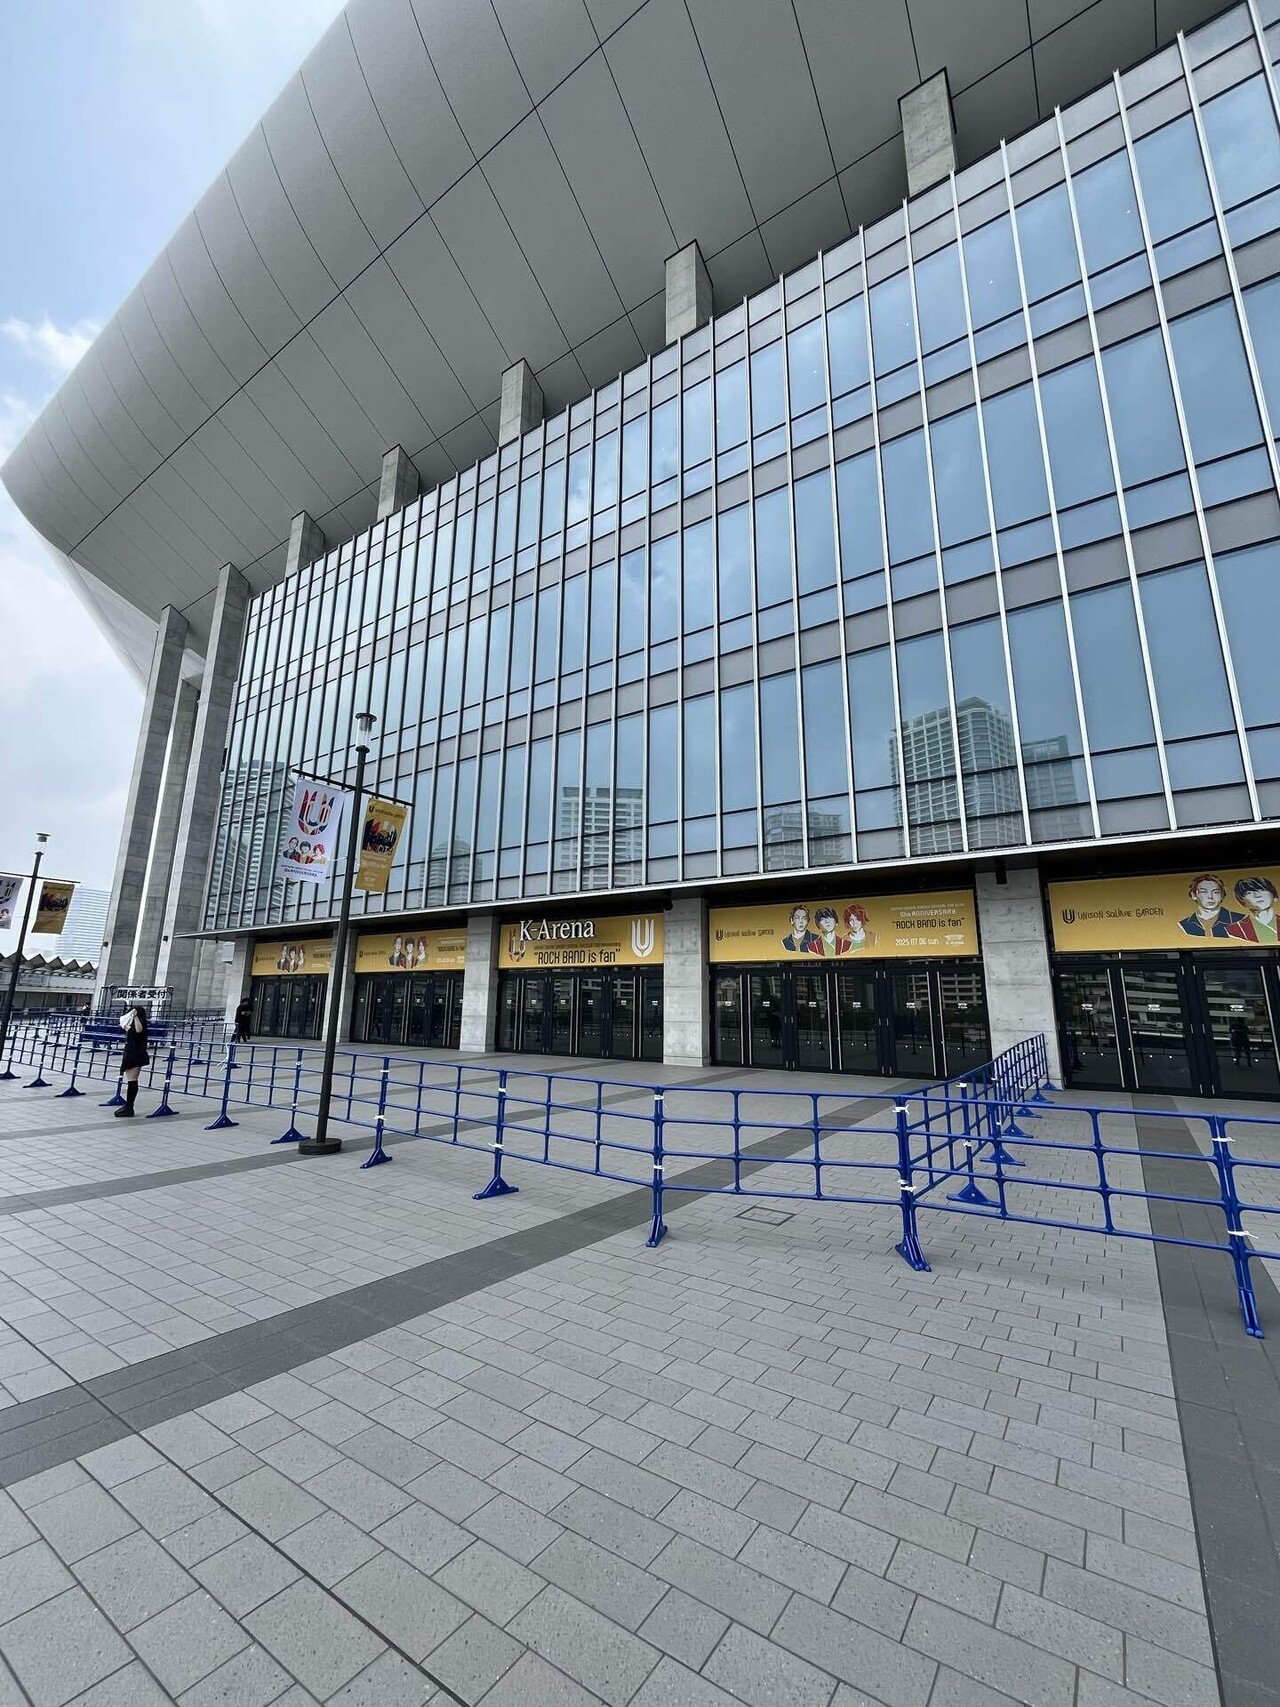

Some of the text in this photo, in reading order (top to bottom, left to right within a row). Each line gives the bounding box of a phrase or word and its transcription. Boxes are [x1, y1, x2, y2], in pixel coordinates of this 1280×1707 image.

[1135, 907, 1164, 918] GARDEN
[519, 918, 595, 941] K-Arena
[917, 919, 937, 928] BAND
[938, 919, 946, 928] is
[562, 949, 586, 964] BAND
[588, 949, 597, 963] is
